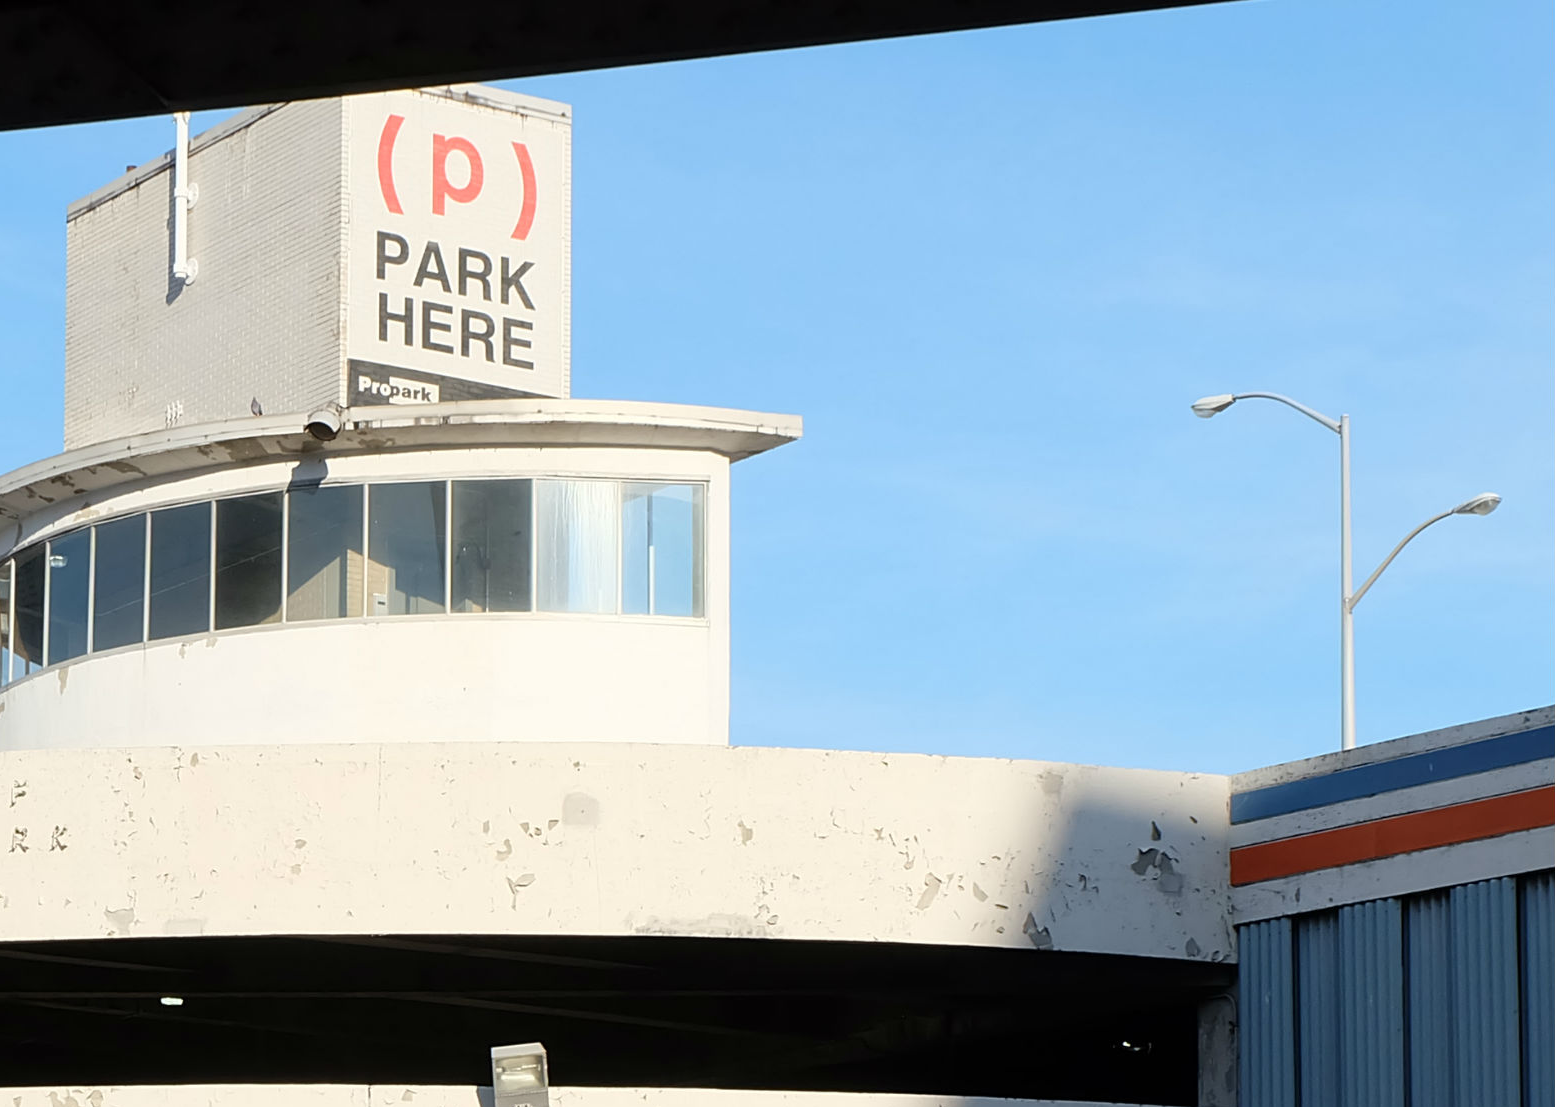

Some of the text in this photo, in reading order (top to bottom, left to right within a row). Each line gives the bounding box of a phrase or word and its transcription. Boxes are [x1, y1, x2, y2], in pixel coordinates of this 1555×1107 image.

[376, 230, 536, 311] PARK
[378, 292, 535, 371] HERE
[358, 374, 432, 403] Propark
